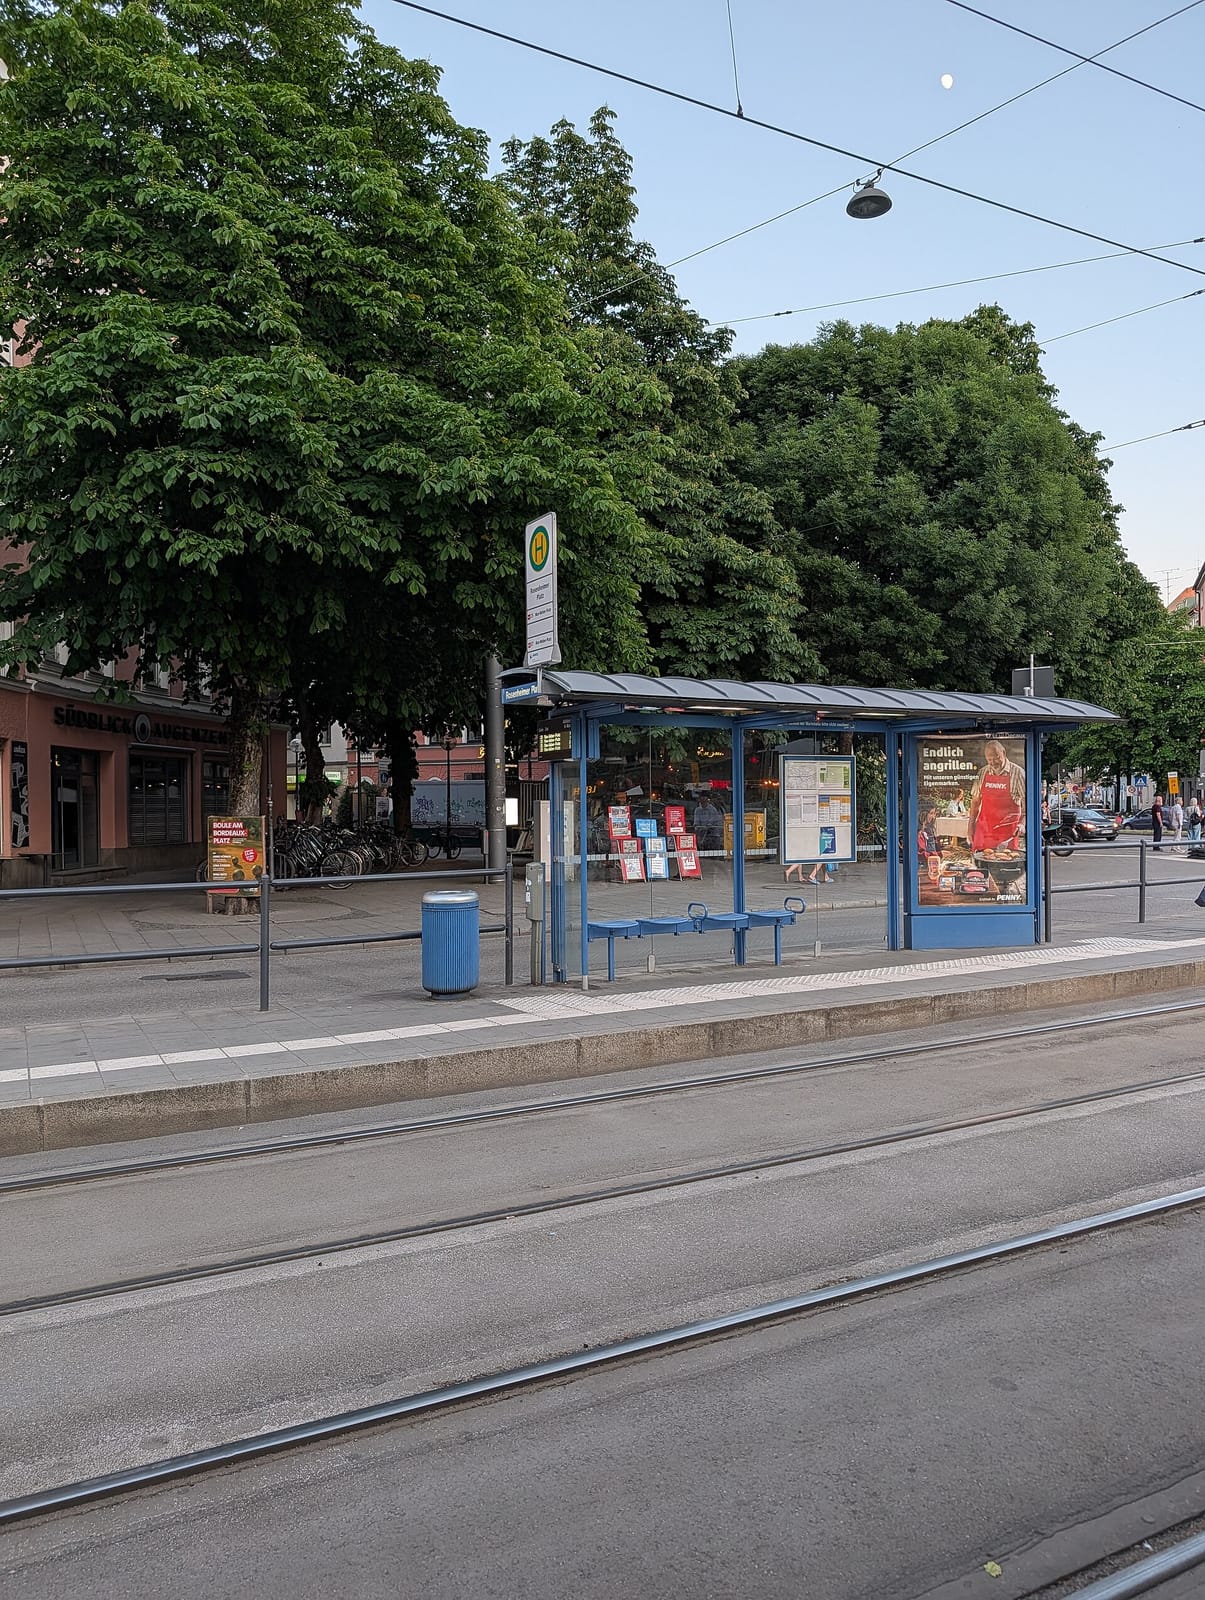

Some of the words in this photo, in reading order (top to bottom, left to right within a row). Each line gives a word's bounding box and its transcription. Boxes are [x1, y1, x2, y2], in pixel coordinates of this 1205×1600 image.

[535, 534, 544, 563] H
[505, 687, 530, 700] Rosenheimer
[54, 704, 132, 735] SÜDBLICK
[923, 746, 964, 758] Endlich
[923, 759, 978, 773] angrillen.
[953, 774, 980, 782] günstigen
